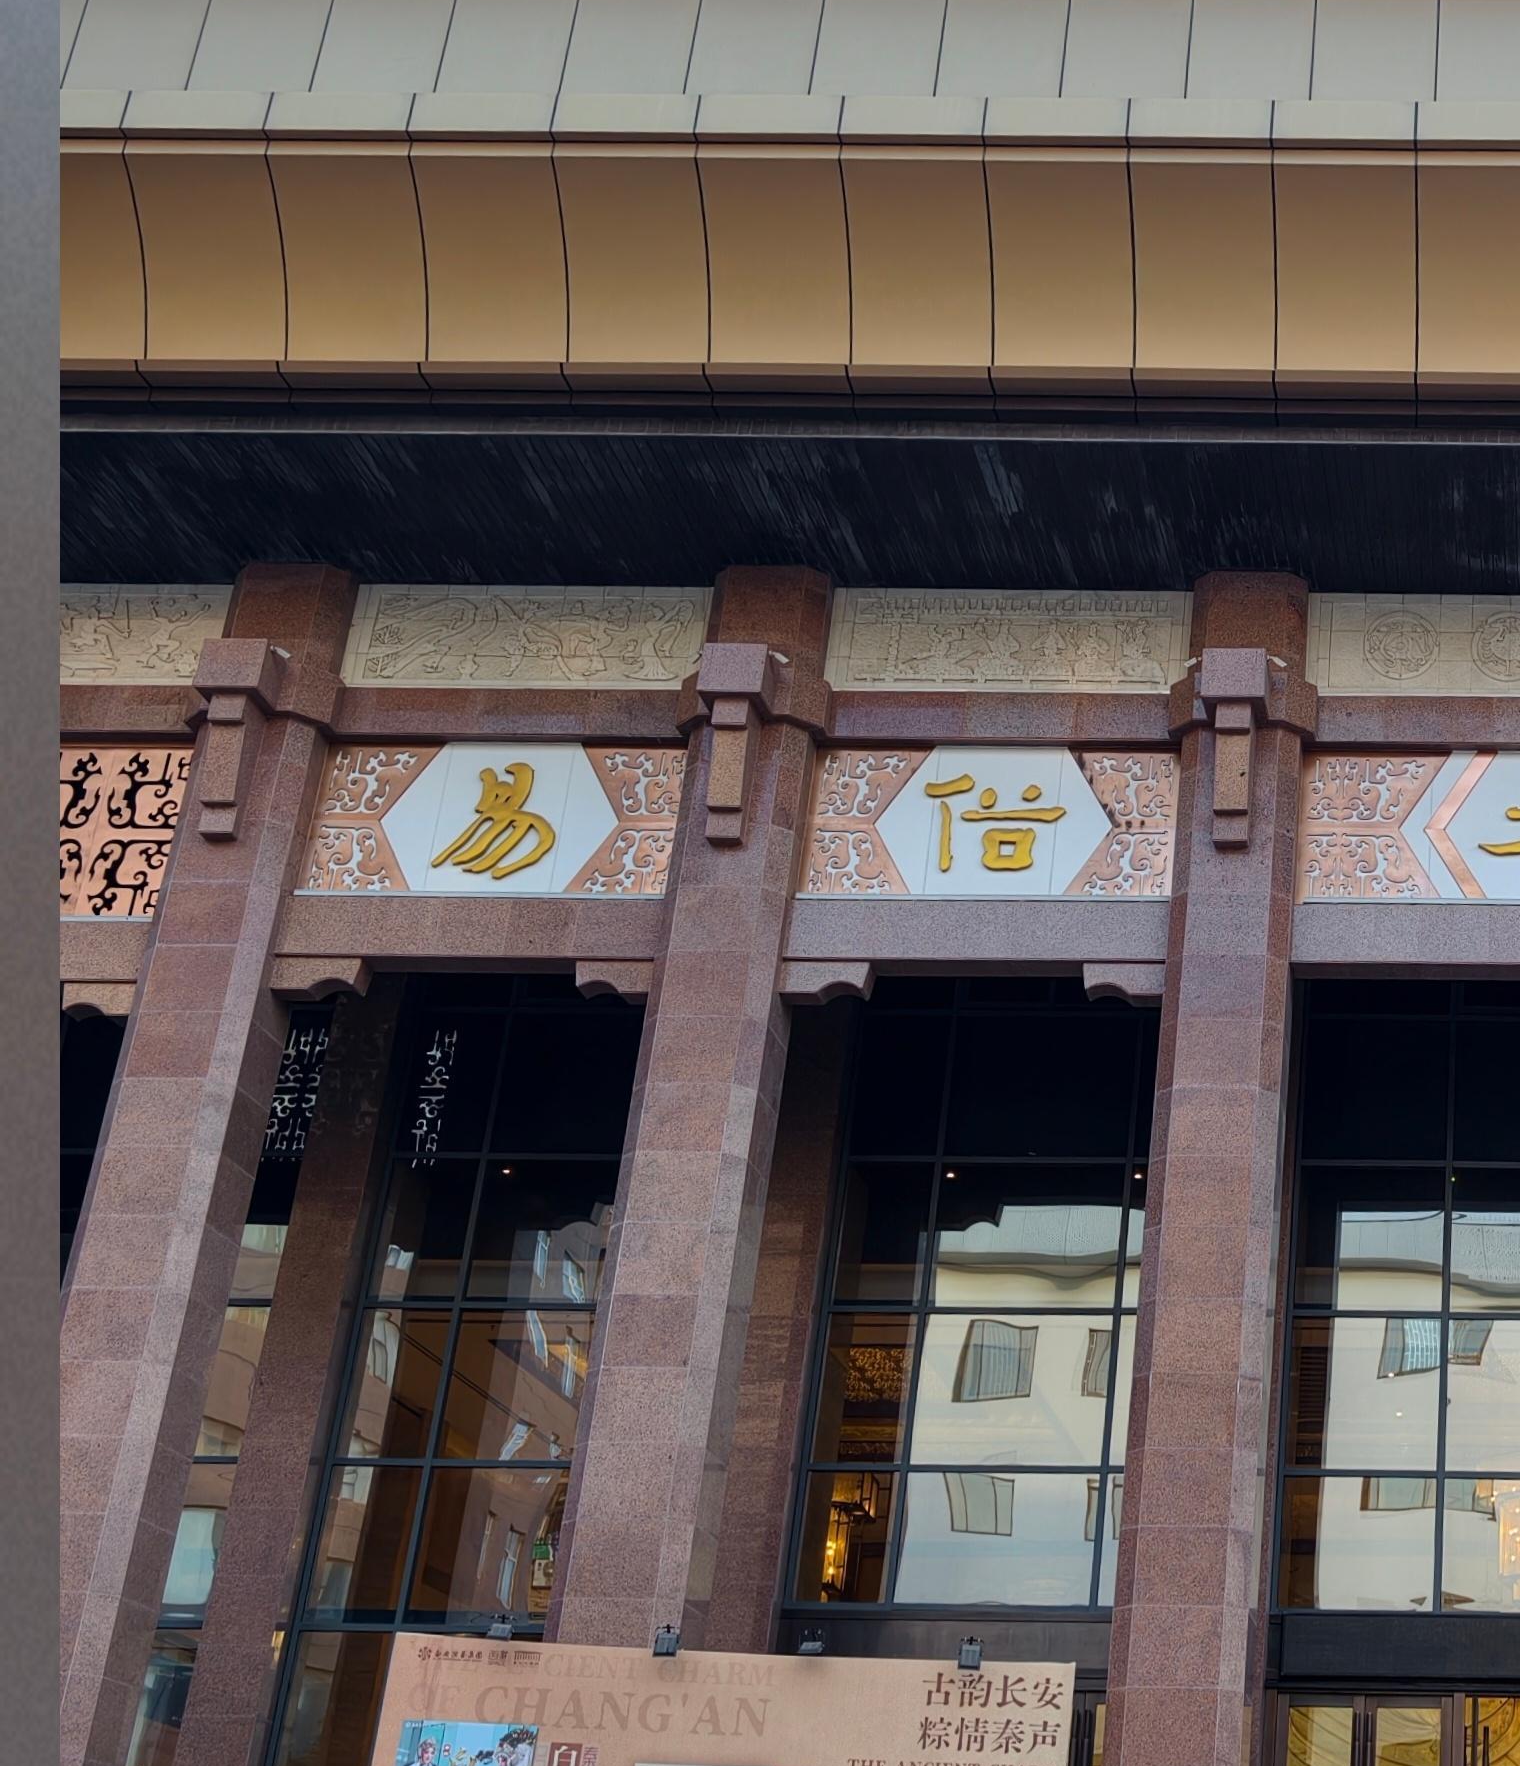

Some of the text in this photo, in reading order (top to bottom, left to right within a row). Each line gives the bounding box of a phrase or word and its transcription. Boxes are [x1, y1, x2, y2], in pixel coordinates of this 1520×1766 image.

[922, 1672, 1065, 1710] 古韵长安
[474, 1685, 773, 1737] CHANG'AN
[917, 1716, 1062, 1754] 粽情秦声
